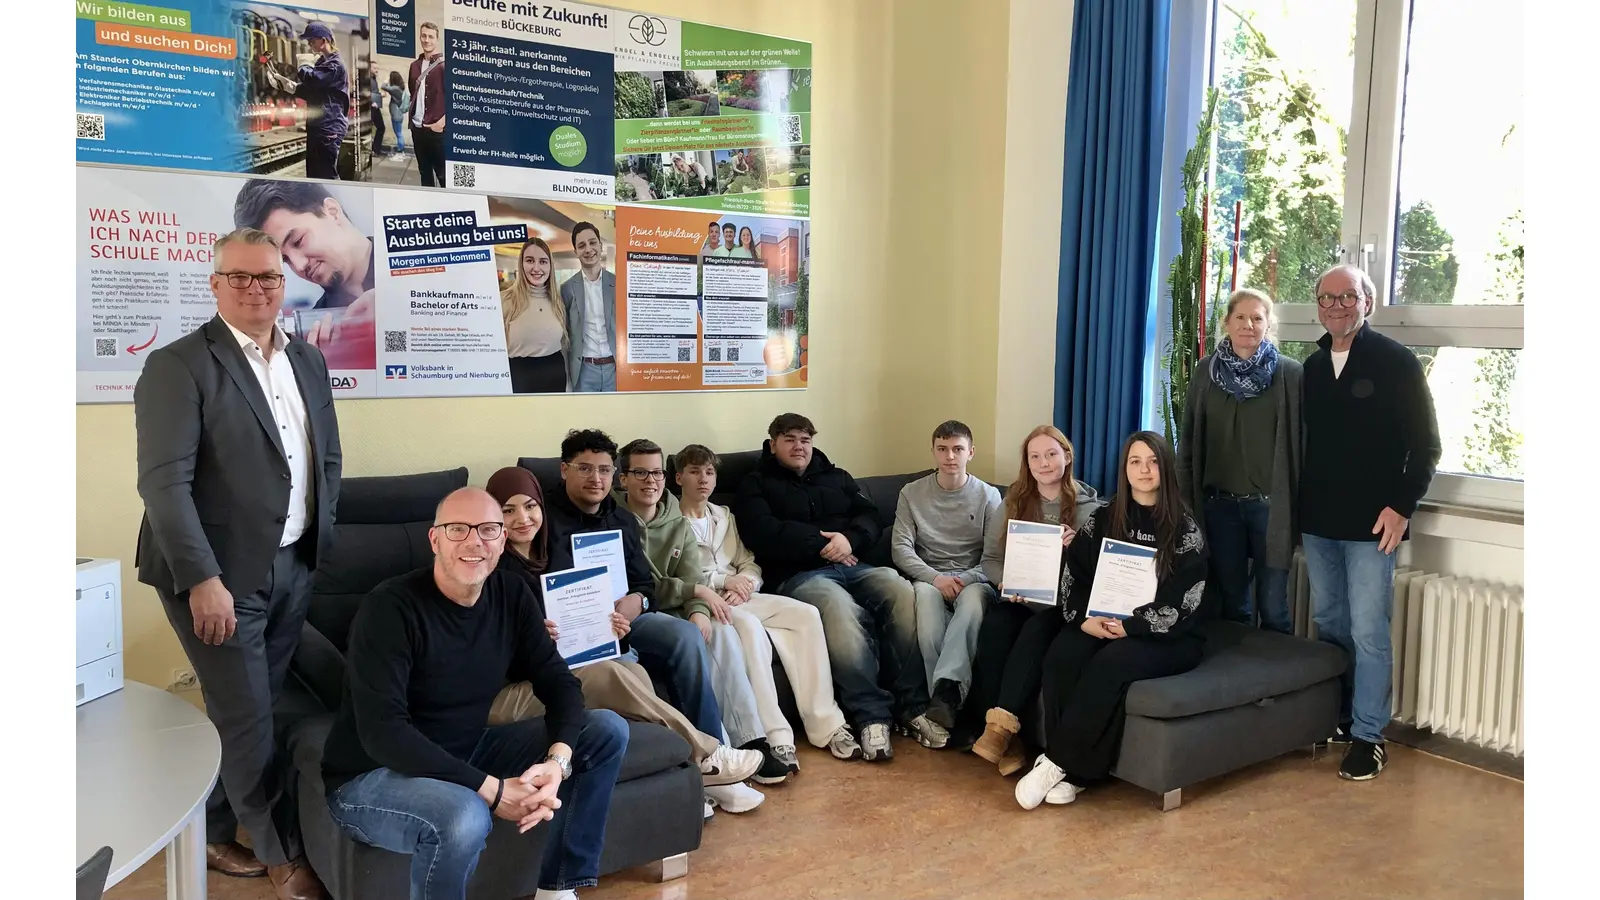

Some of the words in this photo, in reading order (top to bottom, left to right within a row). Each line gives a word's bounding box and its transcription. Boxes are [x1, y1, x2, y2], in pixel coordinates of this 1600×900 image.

[76, 1, 103, 16] Wir
[108, 5, 155, 23] bilden
[160, 15, 186, 27] aus
[381, 11, 400, 19] BERND
[511, 2, 538, 18] mit
[543, 5, 608, 28] Zukunft!
[381, 18, 408, 27] BLINDOW
[466, 16, 499, 28] Standort
[501, 19, 562, 37] BÜCKEBURG
[101, 29, 129, 42] und
[135, 34, 190, 49] suchen
[194, 39, 232, 55] Dich!
[452, 39, 467, 48] 2-3
[468, 40, 489, 52] jähr.
[490, 44, 518, 56] staatl.
[519, 49, 568, 63] anerkannte
[683, 49, 715, 57] Schwimm
[762, 48, 782, 58] grünen
[75, 52, 88, 60] Am
[91, 54, 129, 65] Standort
[132, 58, 191, 72] Obernkirchen
[193, 66, 219, 76] bilden
[84, 63, 131, 74] folgenden
[132, 68, 165, 79] Berufen
[452, 51, 513, 68] Ausbildungen
[515, 60, 530, 70] aus
[532, 61, 549, 72] den
[550, 64, 591, 78] Bereichen
[696, 59, 751, 67] Ausbildungsberuf
[79, 77, 153, 90] Verfahrensmechaniker
[154, 85, 191, 94] Glastechnik
[452, 67, 493, 80] Gesundheit
[565, 82, 600, 94] Logopädie)
[79, 85, 146, 97] Industriemechaniker
[452, 83, 545, 100] Naturwissenschaft/Technik
[79, 92, 120, 101] Elektroniker
[122, 96, 173, 106] Betriebstechnik
[174, 101, 197, 109] m/w/d
[79, 99, 121, 108] Fachlagerist
[452, 93, 477, 102] (Techn.
[479, 96, 531, 108] Assistenzberufe
[545, 103, 556, 111] der
[557, 106, 592, 116] Pharmazie,
[452, 102, 482, 113] Biologie,
[482, 106, 510, 116] Chemie,
[511, 109, 558, 121] Umweltschutz
[559, 114, 571, 122] und
[573, 116, 582, 125] IT)
[452, 117, 491, 130] Gestaltung
[452, 133, 486, 143] Kosmetik
[554, 140, 581, 149] Studium
[555, 132, 577, 141] Duales
[452, 147, 477, 155] Erwerb
[478, 148, 490, 156] der
[490, 150, 518, 160] FH-Reife
[519, 153, 545, 163] möglich
[552, 183, 608, 196] BLINDOW.DE
[89, 208, 131, 224] WAS
[138, 210, 181, 227] WILL
[385, 217, 431, 230] Starte
[434, 214, 473, 228] deine
[89, 226, 120, 241] ICH
[129, 228, 178, 243] NACH
[186, 231, 218, 246] DER
[389, 231, 471, 248] Ausbildung
[473, 229, 494, 242] bei
[497, 226, 526, 239] uns!
[629, 225, 653, 237] Deine
[655, 226, 702, 244] Ausbildung
[629, 237, 642, 247] bei
[643, 240, 658, 249] uns
[91, 244, 159, 260] SCHULE
[168, 248, 215, 263] MACH
[391, 256, 425, 267] Morgen
[427, 254, 449, 264] kann
[450, 251, 488, 262] kommen.
[410, 290, 475, 300] Bankkaufmann
[410, 301, 449, 309] Bachelor
[450, 301, 459, 309] of
[460, 302, 478, 310] Arts
[331, 377, 351, 387] DA
